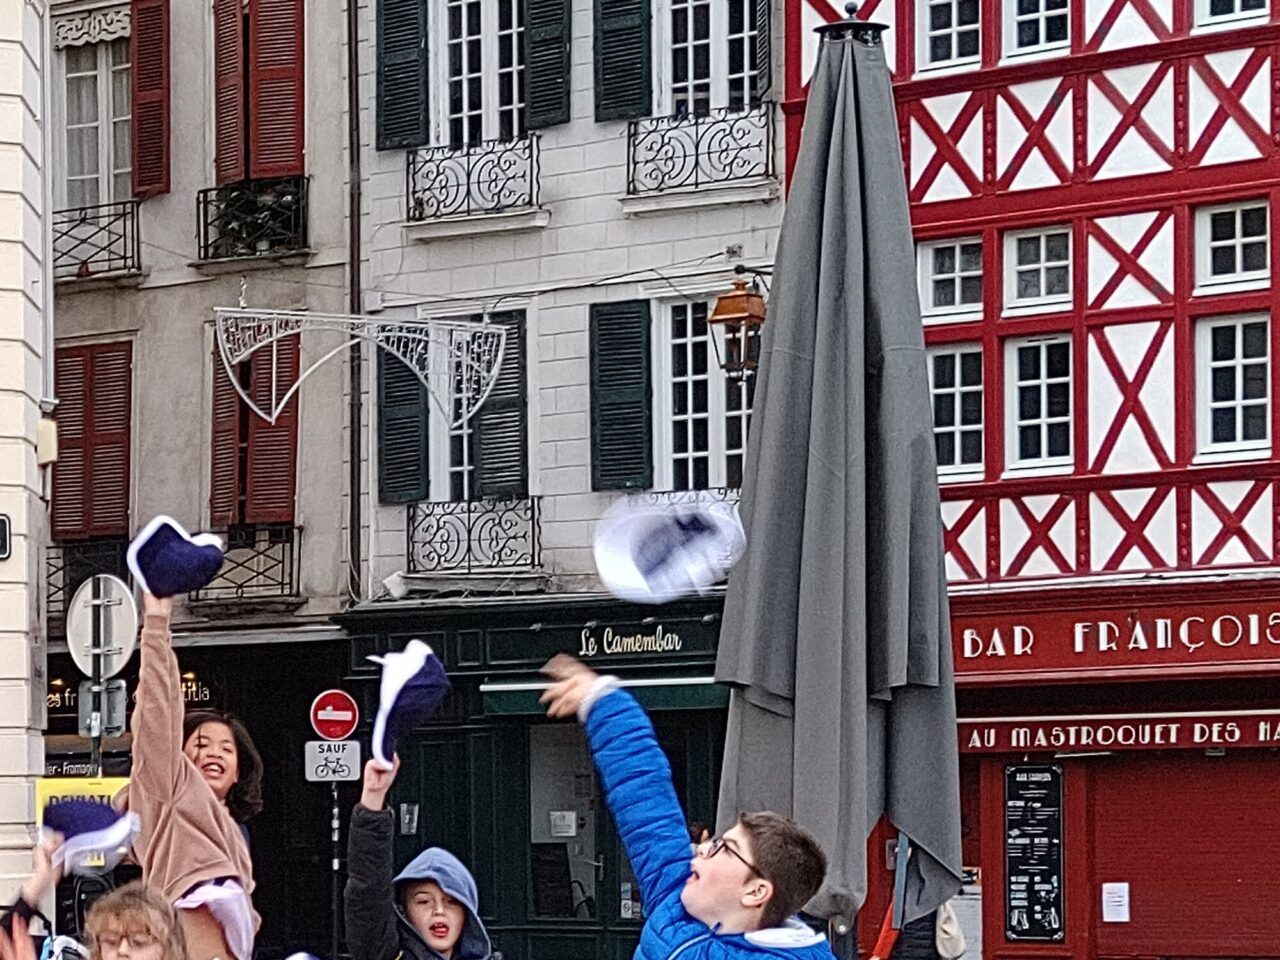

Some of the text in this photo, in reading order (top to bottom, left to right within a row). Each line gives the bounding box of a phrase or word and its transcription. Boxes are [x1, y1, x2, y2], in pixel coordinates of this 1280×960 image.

[579, 624, 682, 656] Le Camembar
[963, 626, 1034, 658] BAR
[318, 743, 348, 754] SAUF
[968, 728, 996, 748] AU
[1011, 724, 1180, 747] MASTROQUET
[1193, 722, 1241, 743] DES
